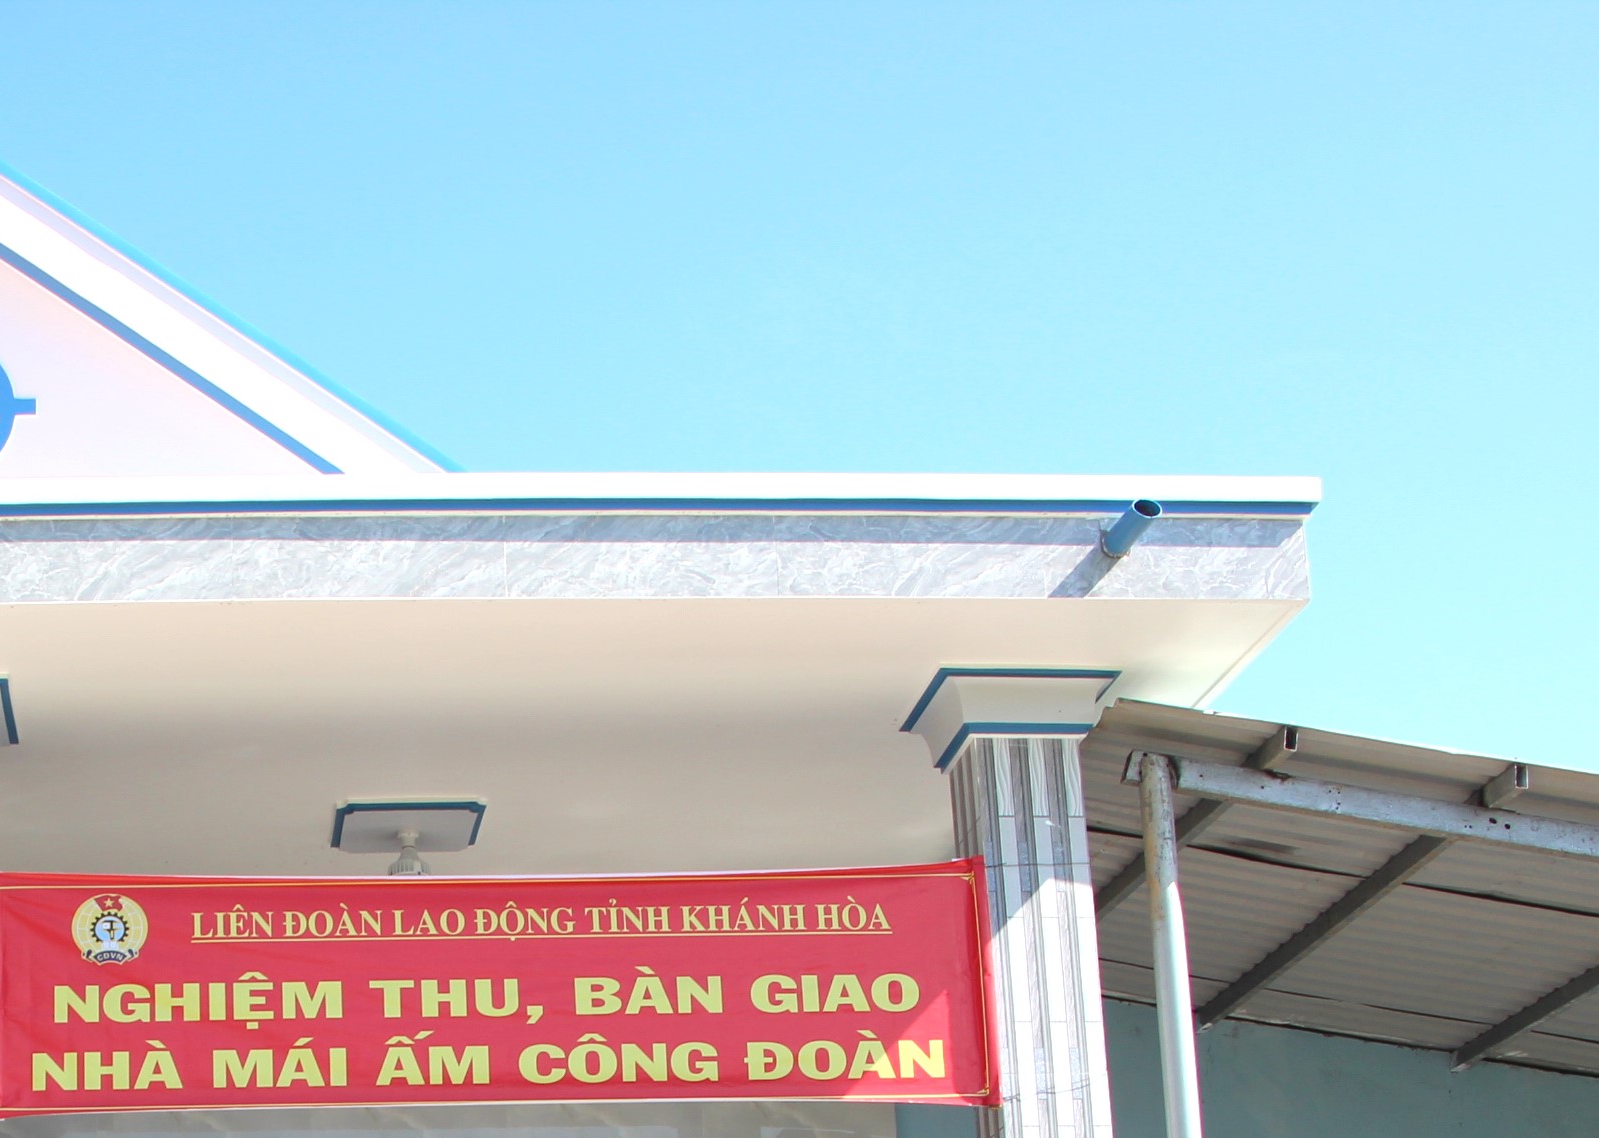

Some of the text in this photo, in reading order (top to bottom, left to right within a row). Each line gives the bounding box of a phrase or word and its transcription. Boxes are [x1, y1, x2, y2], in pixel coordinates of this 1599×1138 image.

[191, 895, 892, 941] LIÊN ĐOÀN LAO ĐỘNG TỈNH KHÁNH HÒA
[53, 966, 920, 1030] NGHIỆM THU, BÀN GIAO
[32, 1029, 946, 1091] NHÀ MÁI ẤM CÔNG ĐOÀN
